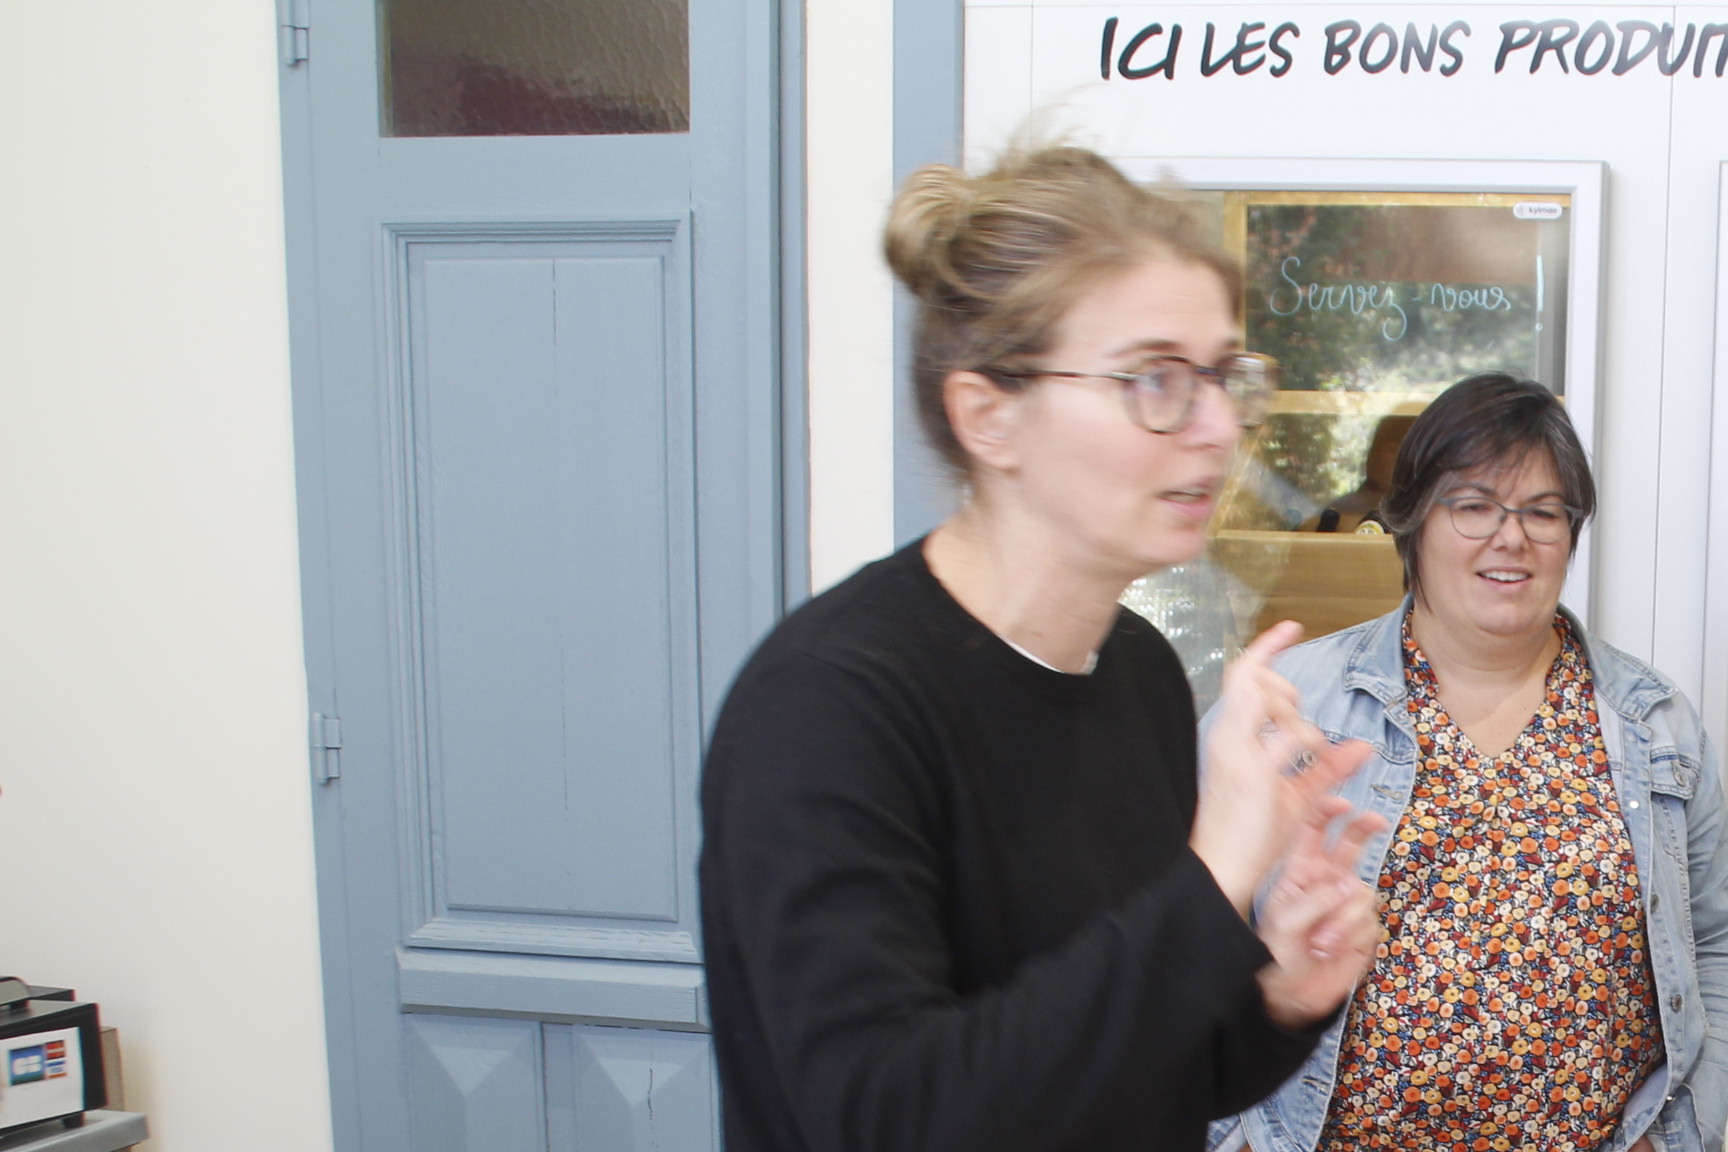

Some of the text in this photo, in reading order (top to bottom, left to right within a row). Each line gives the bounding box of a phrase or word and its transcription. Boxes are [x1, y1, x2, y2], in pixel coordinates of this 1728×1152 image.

[1100, 16, 1182, 80] ICI
[1200, 22, 1300, 77] LES
[1324, 19, 1471, 77] BONS
